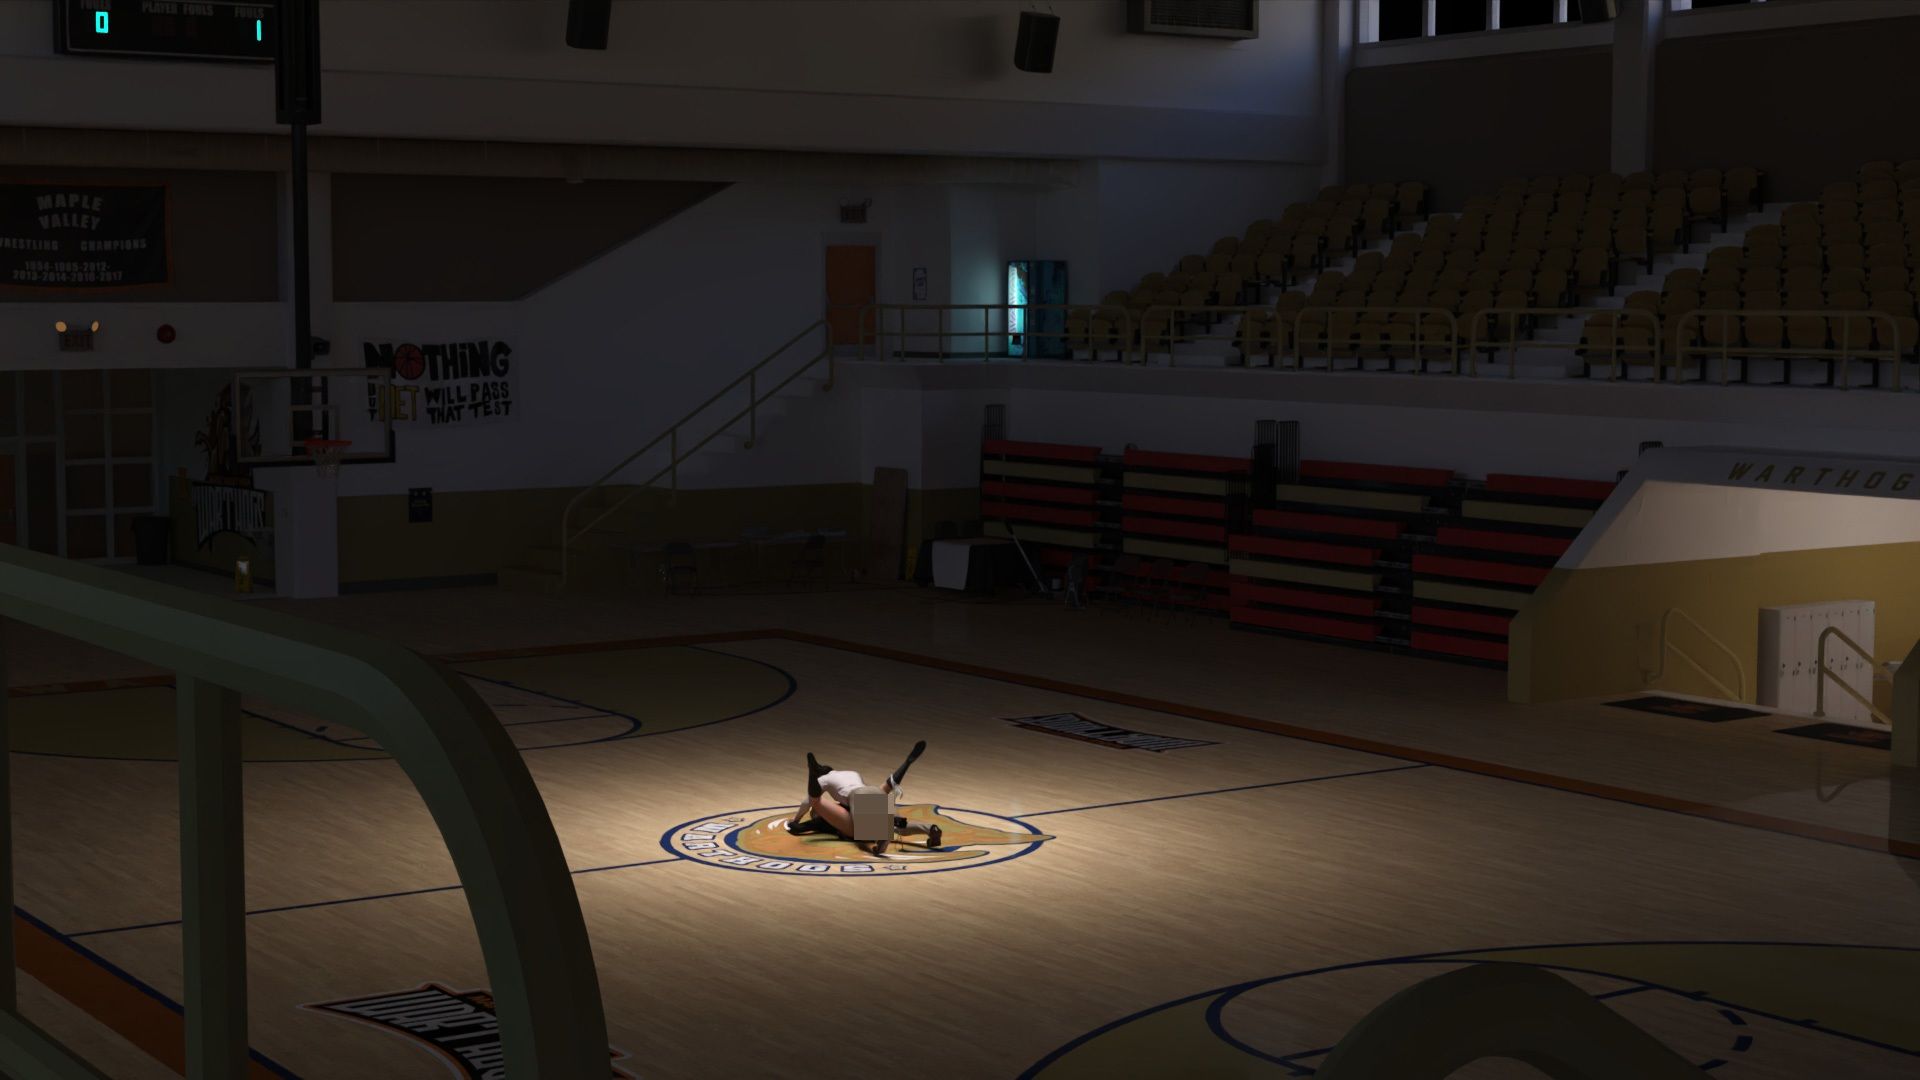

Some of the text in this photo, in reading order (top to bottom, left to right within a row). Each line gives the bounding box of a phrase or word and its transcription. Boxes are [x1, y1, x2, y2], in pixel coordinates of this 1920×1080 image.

[142, 1, 214, 17] PLAYER FOULS
[233, 7, 265, 19] FOULS
[95, 11, 111, 34] 0
[36, 193, 104, 212] MAPLE
[38, 213, 101, 231] VALLEY
[80, 238, 147, 251] CHAMPIONS
[424, 382, 509, 405] WILL PASS
[426, 401, 512, 424] THAT TEST
[1728, 462, 1916, 491] WARTHOG
